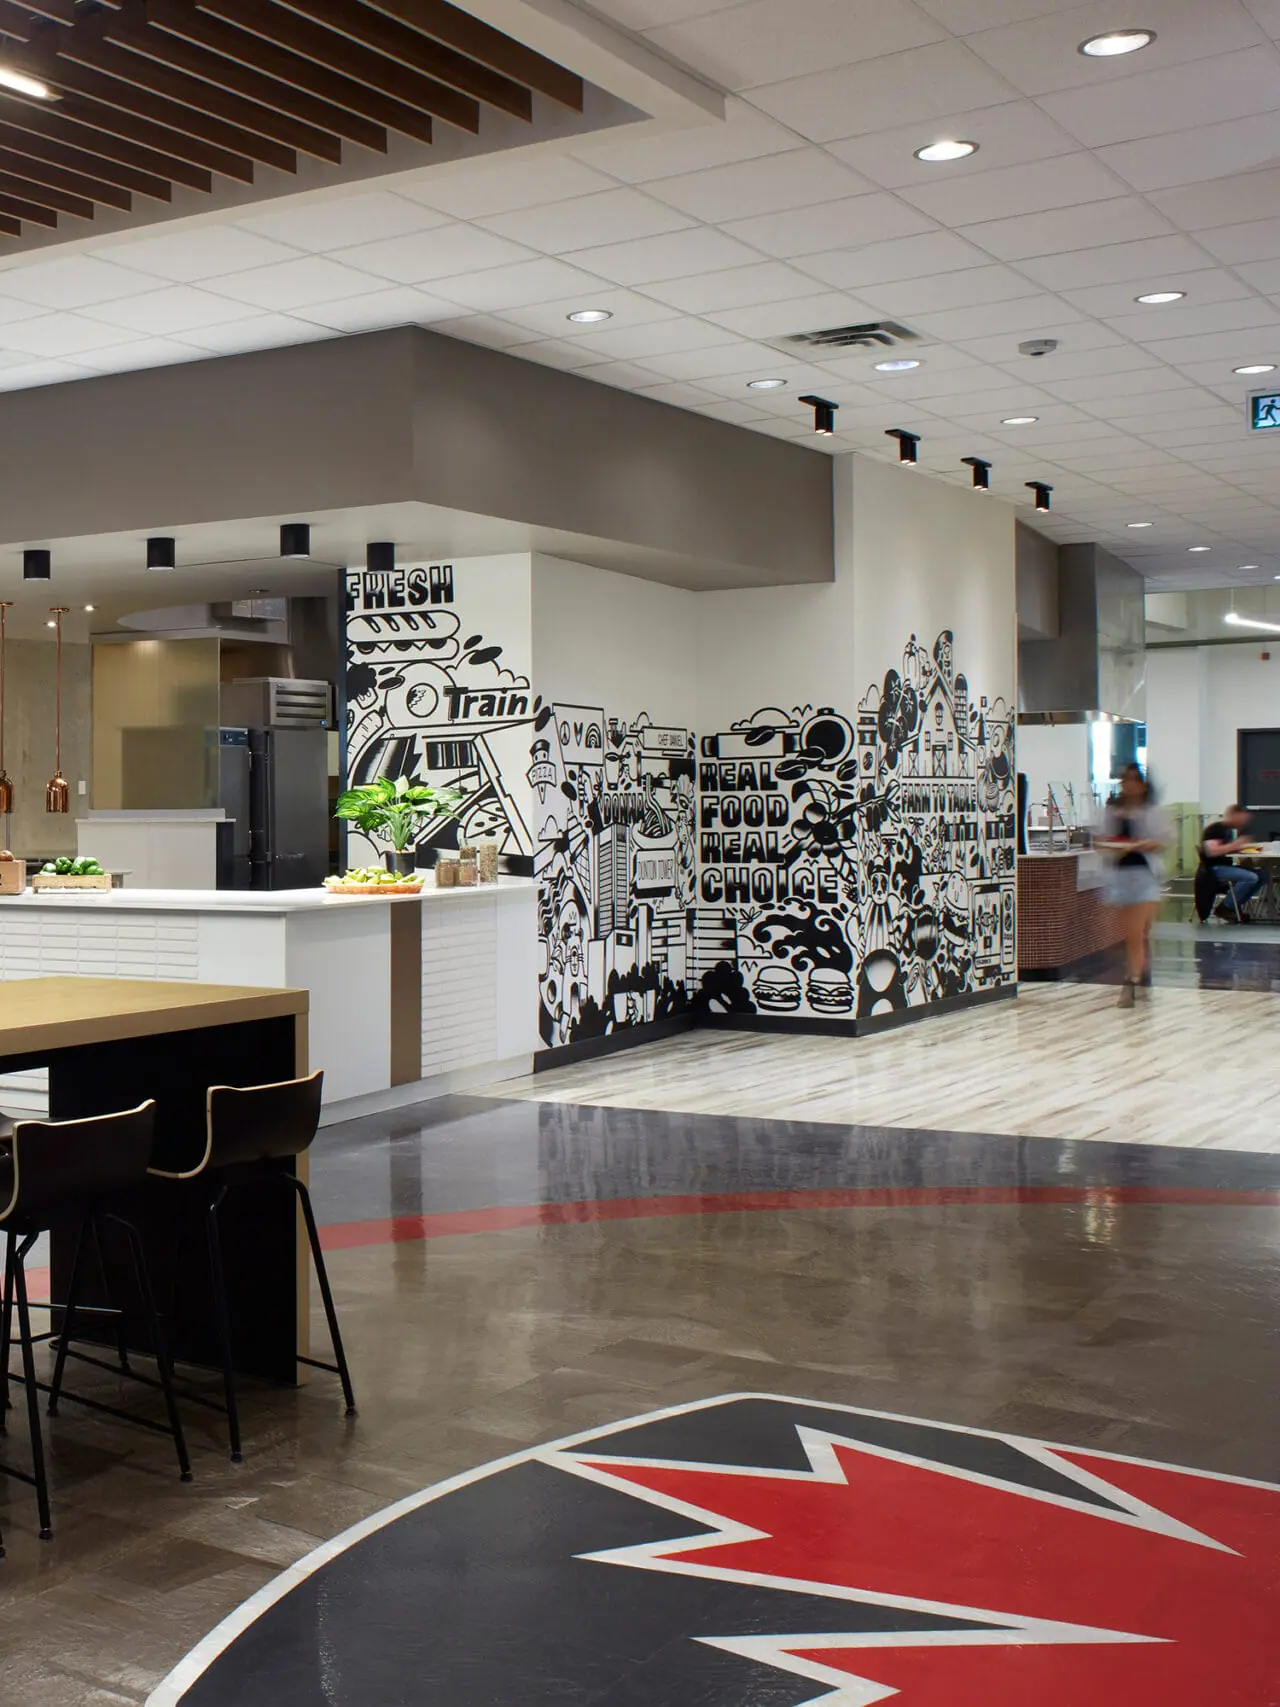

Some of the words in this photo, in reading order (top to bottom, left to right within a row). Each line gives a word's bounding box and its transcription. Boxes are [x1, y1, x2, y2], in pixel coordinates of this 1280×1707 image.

[346, 565, 455, 611] FRESH
[443, 685, 530, 721] Train
[531, 766, 553, 782] PIZZA
[699, 761, 778, 792] REAL
[700, 794, 789, 828] FOOD
[901, 783, 930, 813] FARM
[932, 783, 946, 813] TO
[947, 783, 977, 813] TABLE
[701, 831, 785, 864] REAL
[701, 867, 839, 904] CHOICE
